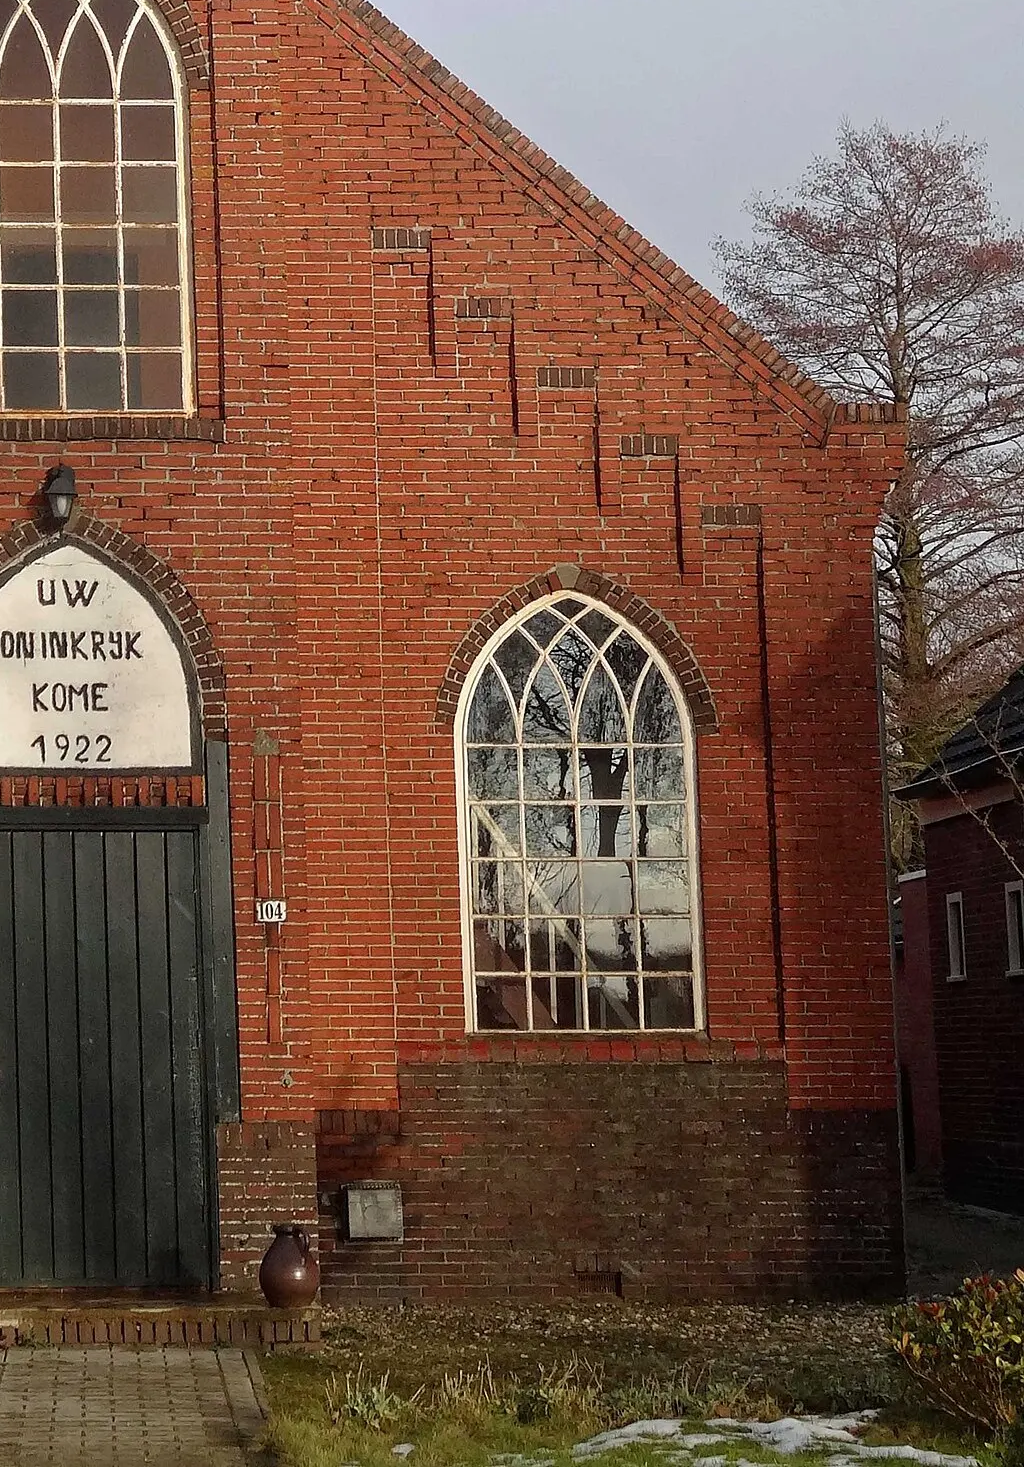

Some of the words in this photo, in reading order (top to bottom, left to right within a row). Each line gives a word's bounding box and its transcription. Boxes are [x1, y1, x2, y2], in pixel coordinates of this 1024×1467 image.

[37, 579, 99, 607] UW
[32, 682, 109, 712] KOME
[30, 733, 112, 764] 1922
[258, 902, 283, 920] 104
